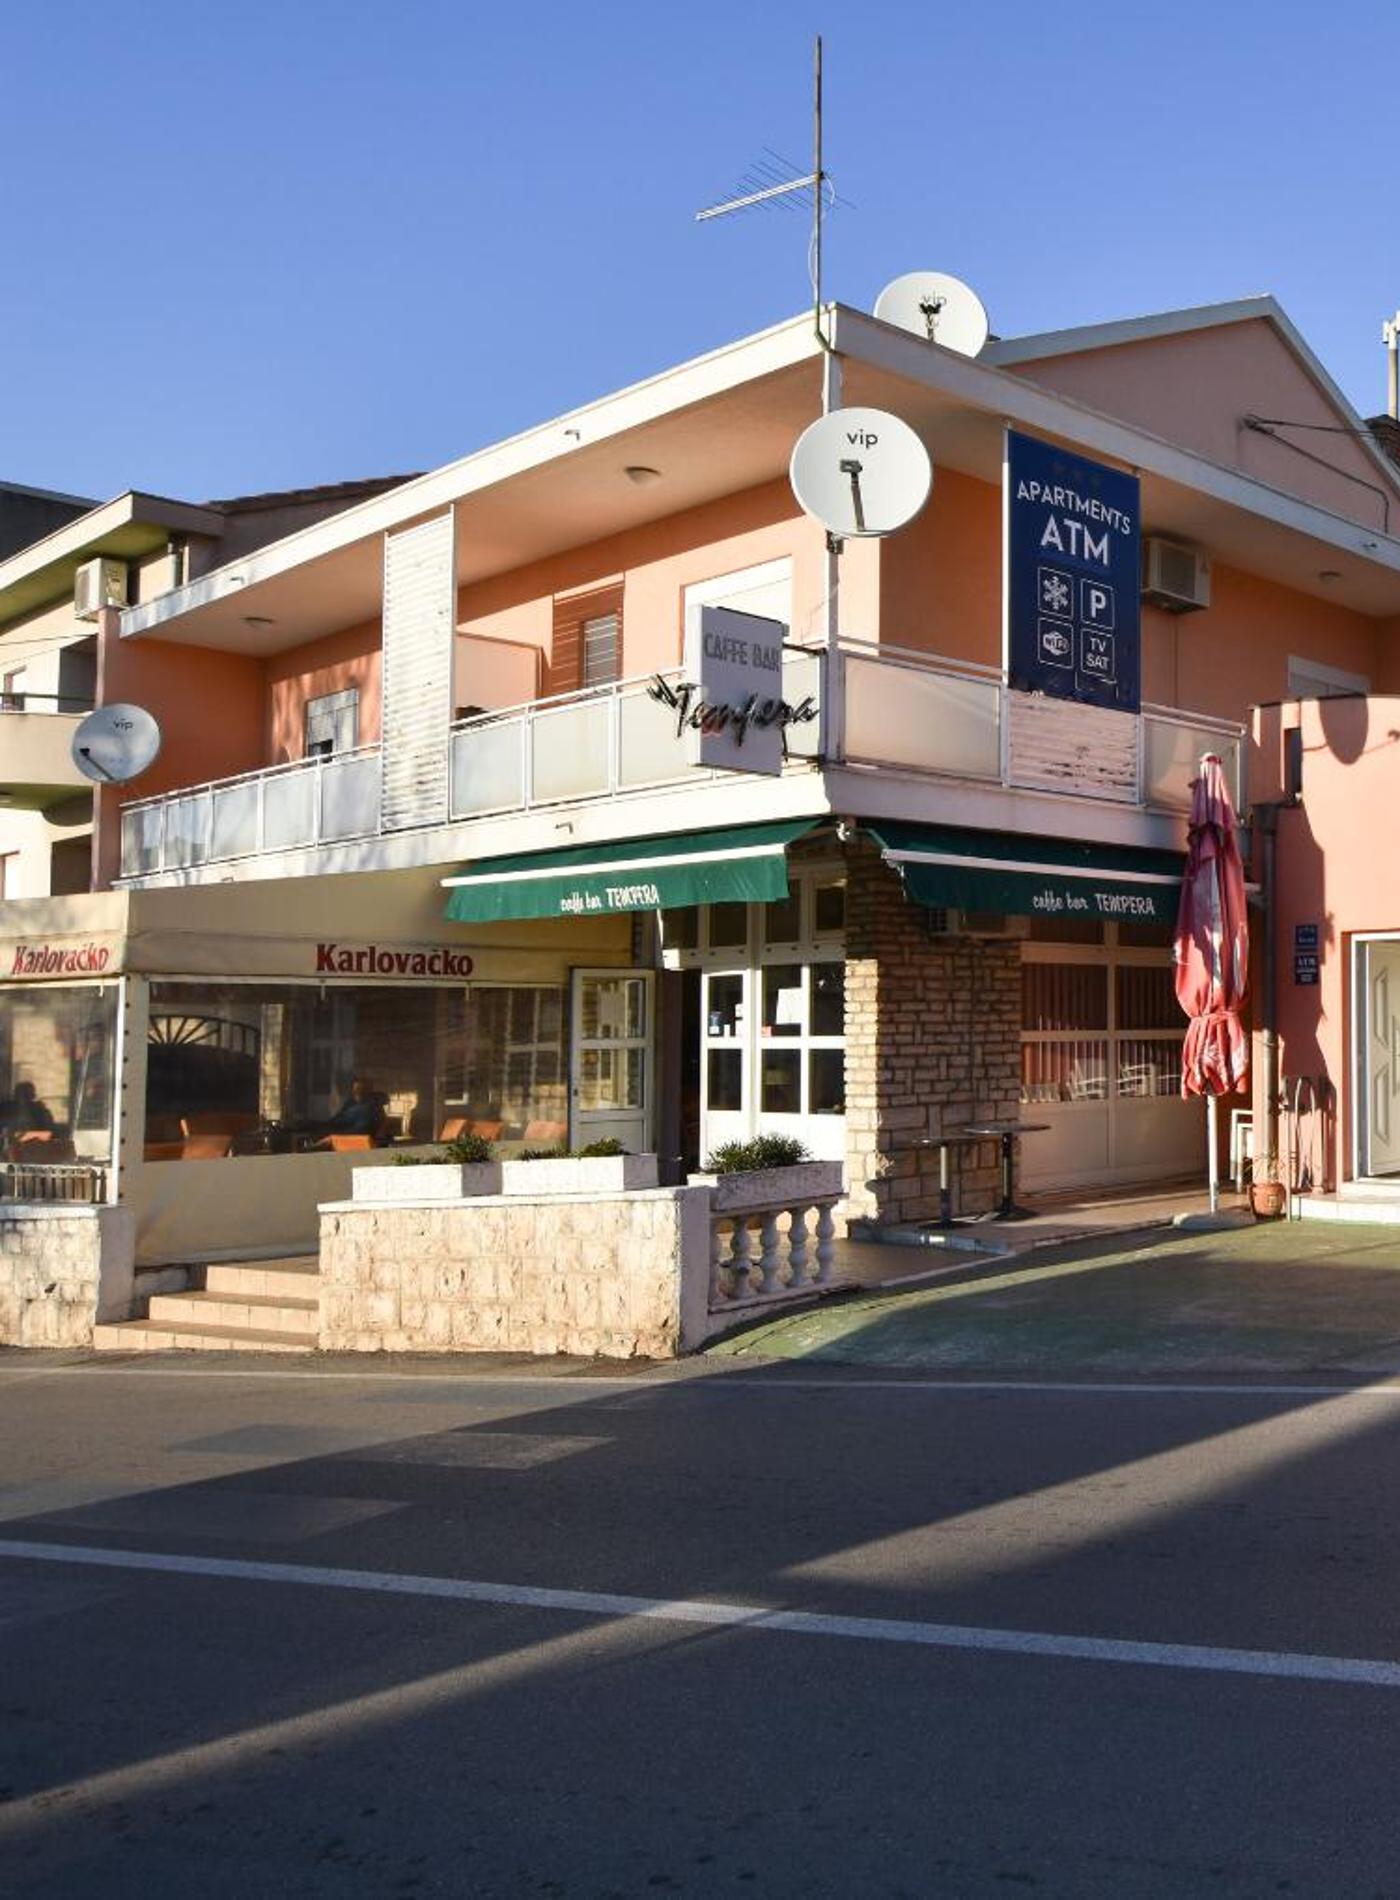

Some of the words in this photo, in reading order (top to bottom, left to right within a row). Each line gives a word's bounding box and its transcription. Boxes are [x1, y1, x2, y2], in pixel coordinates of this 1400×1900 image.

[846, 428, 879, 449] vip
[1017, 480, 1131, 535] APARTMENTS
[1041, 514, 1108, 566] ATM
[1090, 589, 1106, 618] P
[704, 632, 748, 666] CAFFE
[752, 643, 780, 672] BAR
[1089, 637, 1106, 652] TV
[1086, 652, 1110, 670] SAT
[112, 718, 134, 731] vip
[1095, 892, 1156, 915] TEMPERA
[11, 942, 109, 975] Karlovačko
[316, 943, 474, 976] Karlovačko
